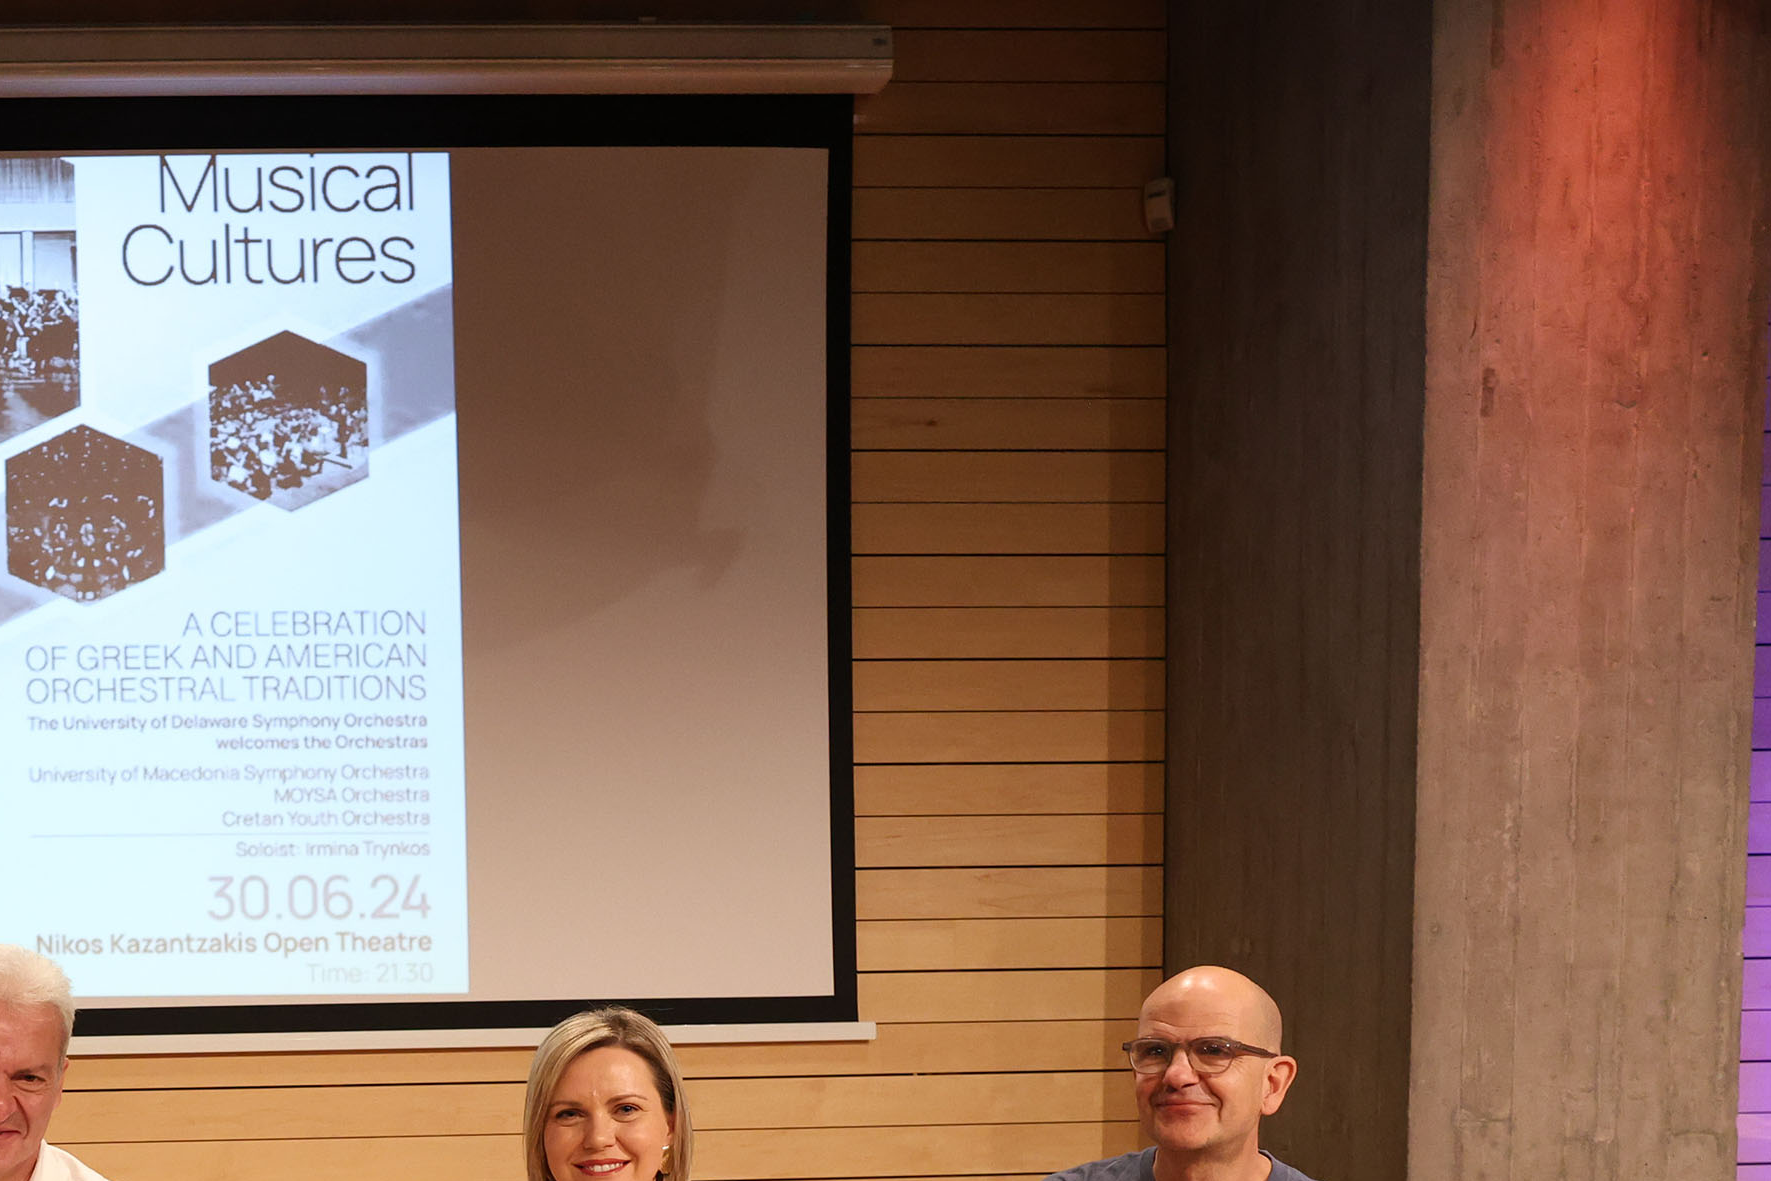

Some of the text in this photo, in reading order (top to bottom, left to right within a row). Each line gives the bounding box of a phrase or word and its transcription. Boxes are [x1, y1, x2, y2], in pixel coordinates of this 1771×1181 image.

[159, 153, 414, 213] Musical
[122, 223, 416, 286] Cultures
[182, 610, 427, 638] A CELEBRATION
[25, 642, 427, 672] OF GREEK AND AMERICAN
[25, 674, 427, 704] ORCHESTRAL TRADITIONS
[28, 713, 428, 733] The University of Delaware Symphony Orchestra
[216, 734, 429, 750] welcomes the Orchestras
[28, 764, 430, 787] University of Macedonia Symphony Orchestra
[273, 787, 431, 804] MOYSA Orchestra
[221, 810, 431, 828] Cretan Youth Orchestra
[235, 841, 431, 861] Soloist: Irmina Trynkos
[206, 874, 432, 922] 30.06.24
[36, 930, 433, 959] Nikos Kazantzakis Open Theatre
